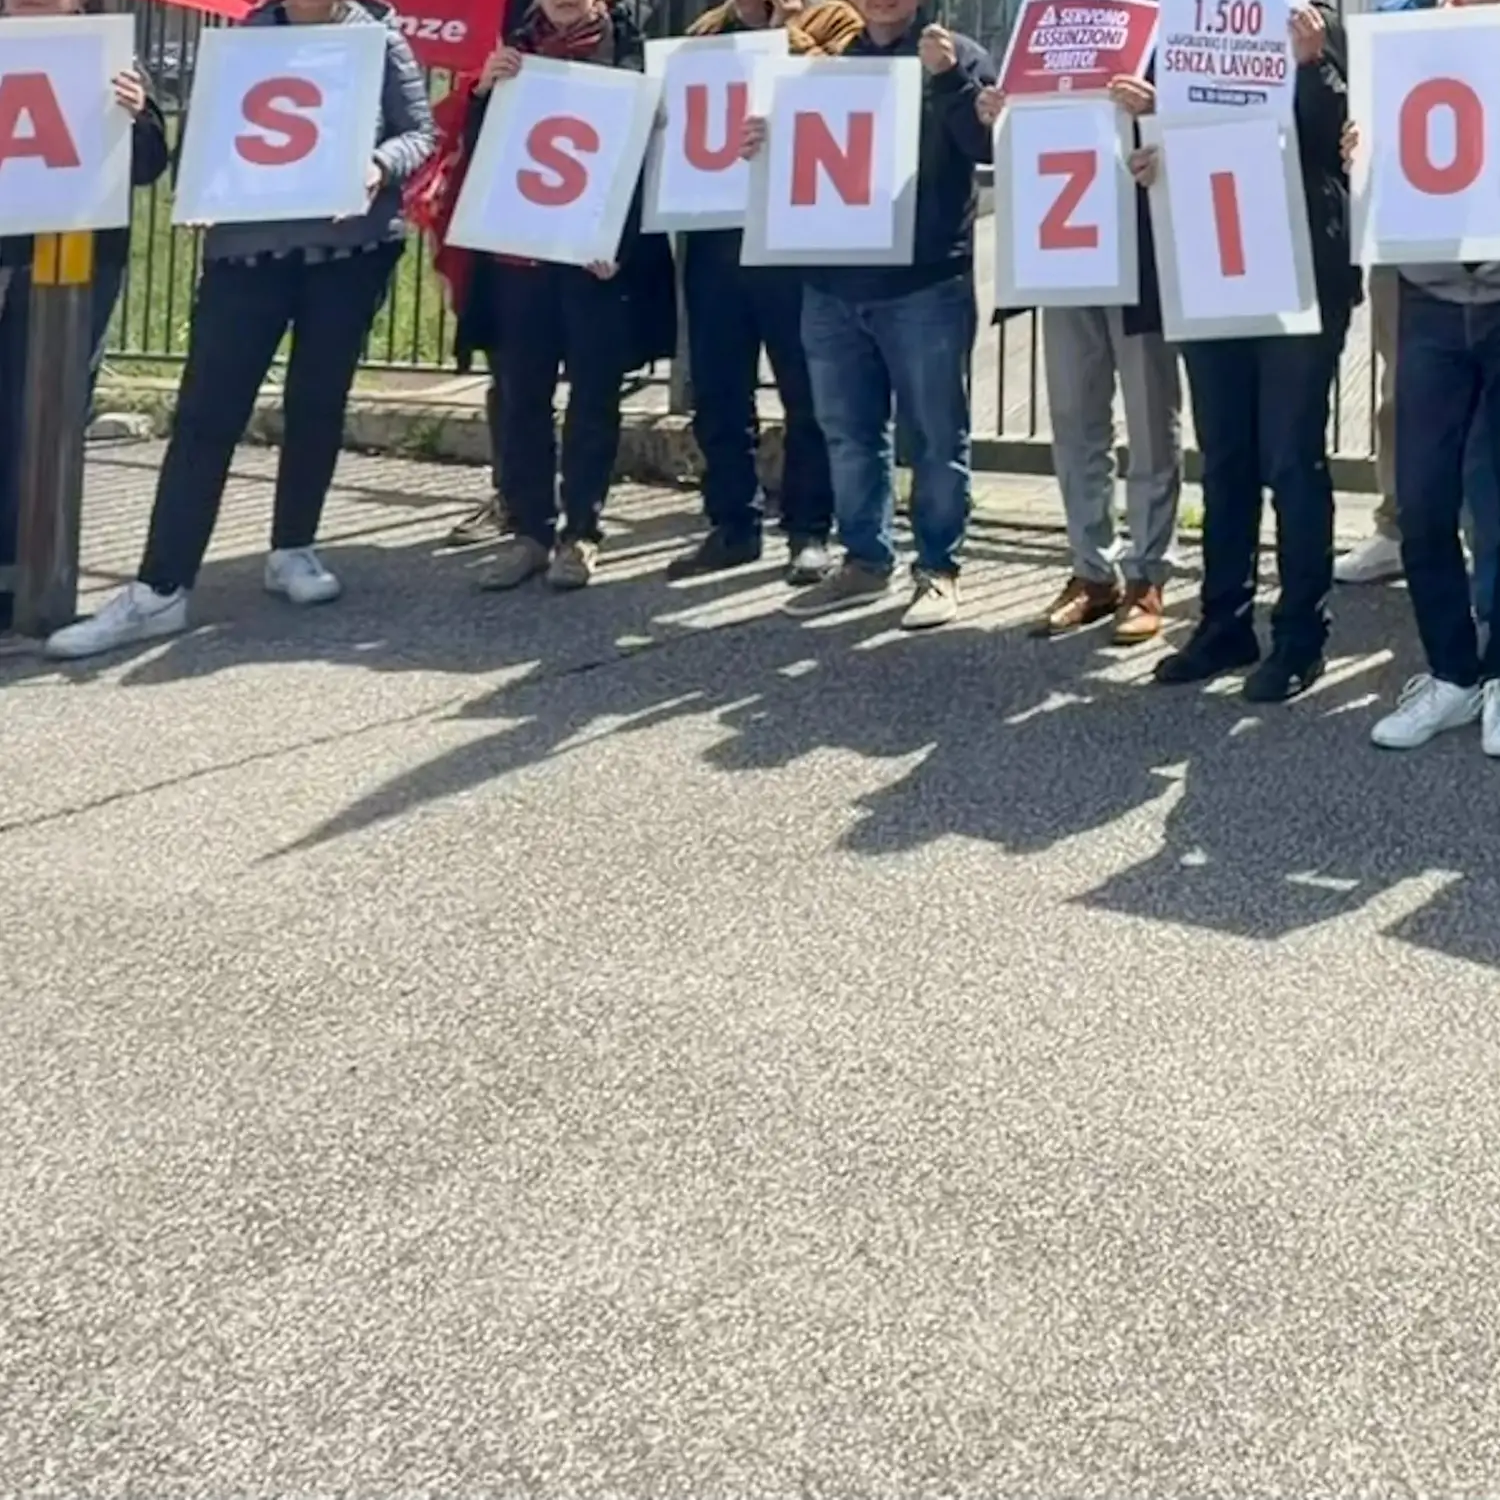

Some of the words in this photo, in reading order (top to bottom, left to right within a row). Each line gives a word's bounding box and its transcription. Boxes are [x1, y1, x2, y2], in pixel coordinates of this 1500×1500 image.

[1034, 29, 1124, 47] ASSUNZIONI
[1165, 50, 1216, 75] SENZA
[1221, 54, 1287, 80] LAVORO
[0, 72, 81, 168] A
[234, 77, 323, 167] S
[516, 115, 600, 207] S
[683, 82, 748, 172] U
[790, 112, 874, 206] N
[1399, 77, 1484, 195] O
[1038, 150, 1098, 250] Z
[1210, 171, 1245, 277] I
